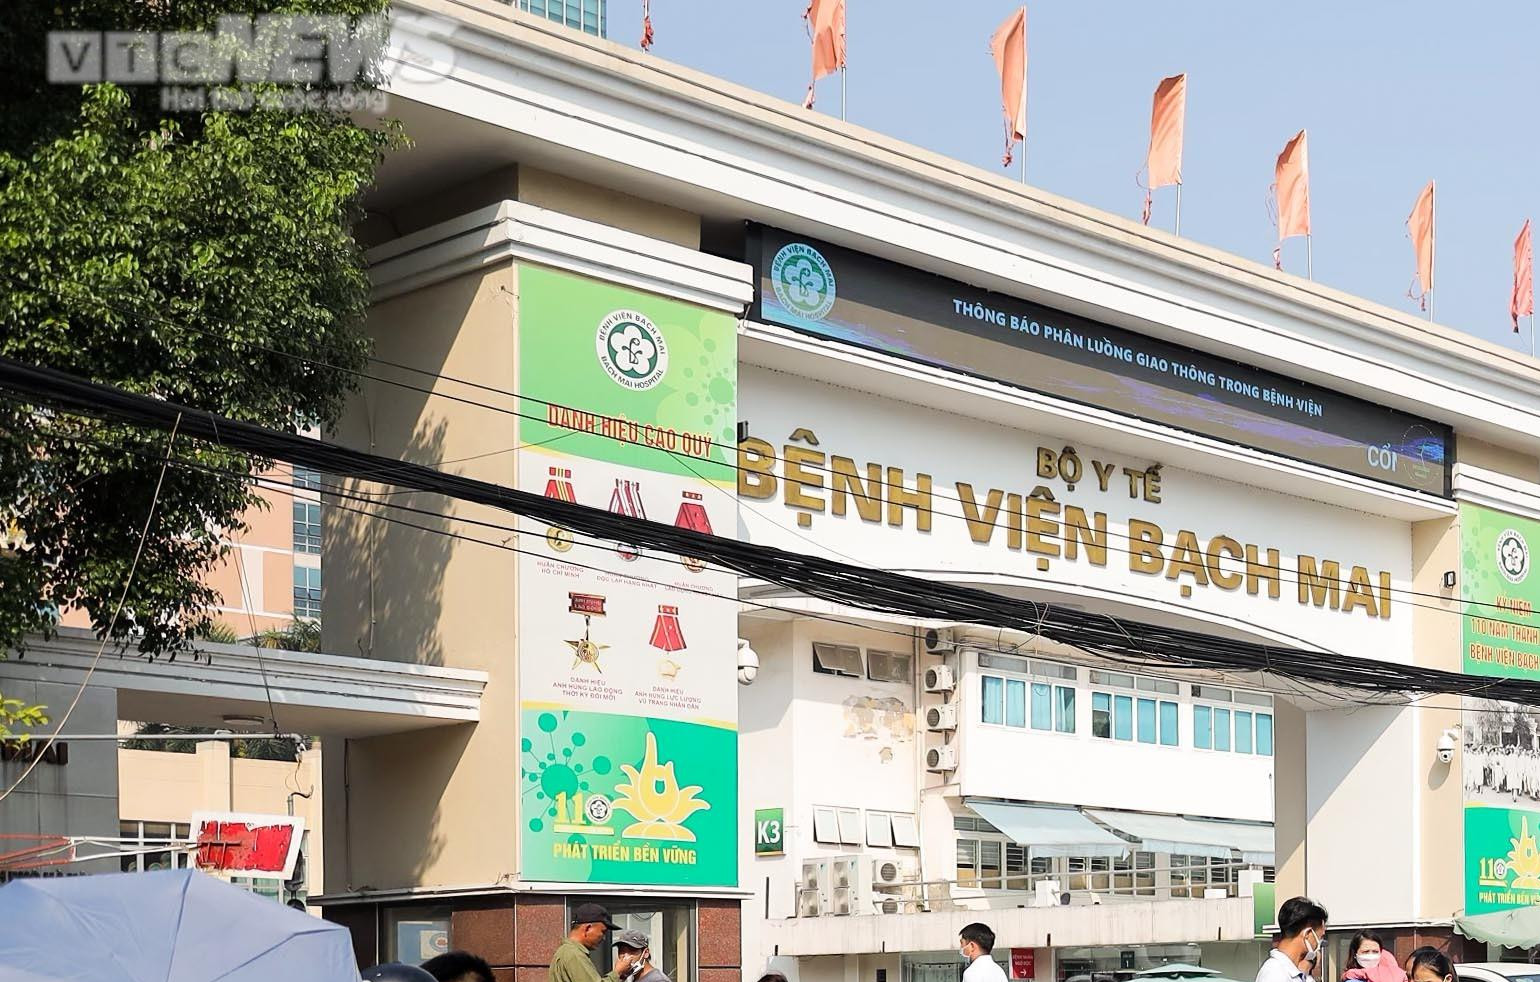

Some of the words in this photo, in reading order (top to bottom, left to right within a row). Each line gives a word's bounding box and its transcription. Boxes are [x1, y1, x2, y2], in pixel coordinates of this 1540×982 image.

[953, 299, 1006, 326] THÔNG
[1010, 315, 1040, 336] BÁO
[1043, 325, 1084, 349] PHÂN
[1088, 336, 1133, 363] LUỒNG
[1136, 352, 1168, 373] GIAO
[1171, 363, 1216, 387] THÔNG
[1218, 375, 1260, 399] TRONG
[1263, 388, 1294, 408] BỆNH
[1297, 398, 1323, 417] VIỆN
[547, 403, 596, 433] DANH
[601, 414, 638, 447] HIỆU
[644, 424, 676, 451] CAO
[682, 432, 712, 457] QUÝ
[1036, 445, 1083, 491] BỘ
[1092, 460, 1116, 492] Y
[1123, 461, 1165, 504] TẾ
[737, 428, 932, 531] BỆNH
[956, 486, 1107, 571] VIỆN
[1128, 518, 1281, 599] BẠCH
[1297, 554, 1392, 619] MAI
[1471, 617, 1486, 635] 110
[553, 841, 589, 860] PHÁT
[592, 840, 630, 861] TRIỂN
[634, 842, 660, 863] BỀN
[663, 845, 697, 865] VỮNG
[758, 820, 780, 844] K3
